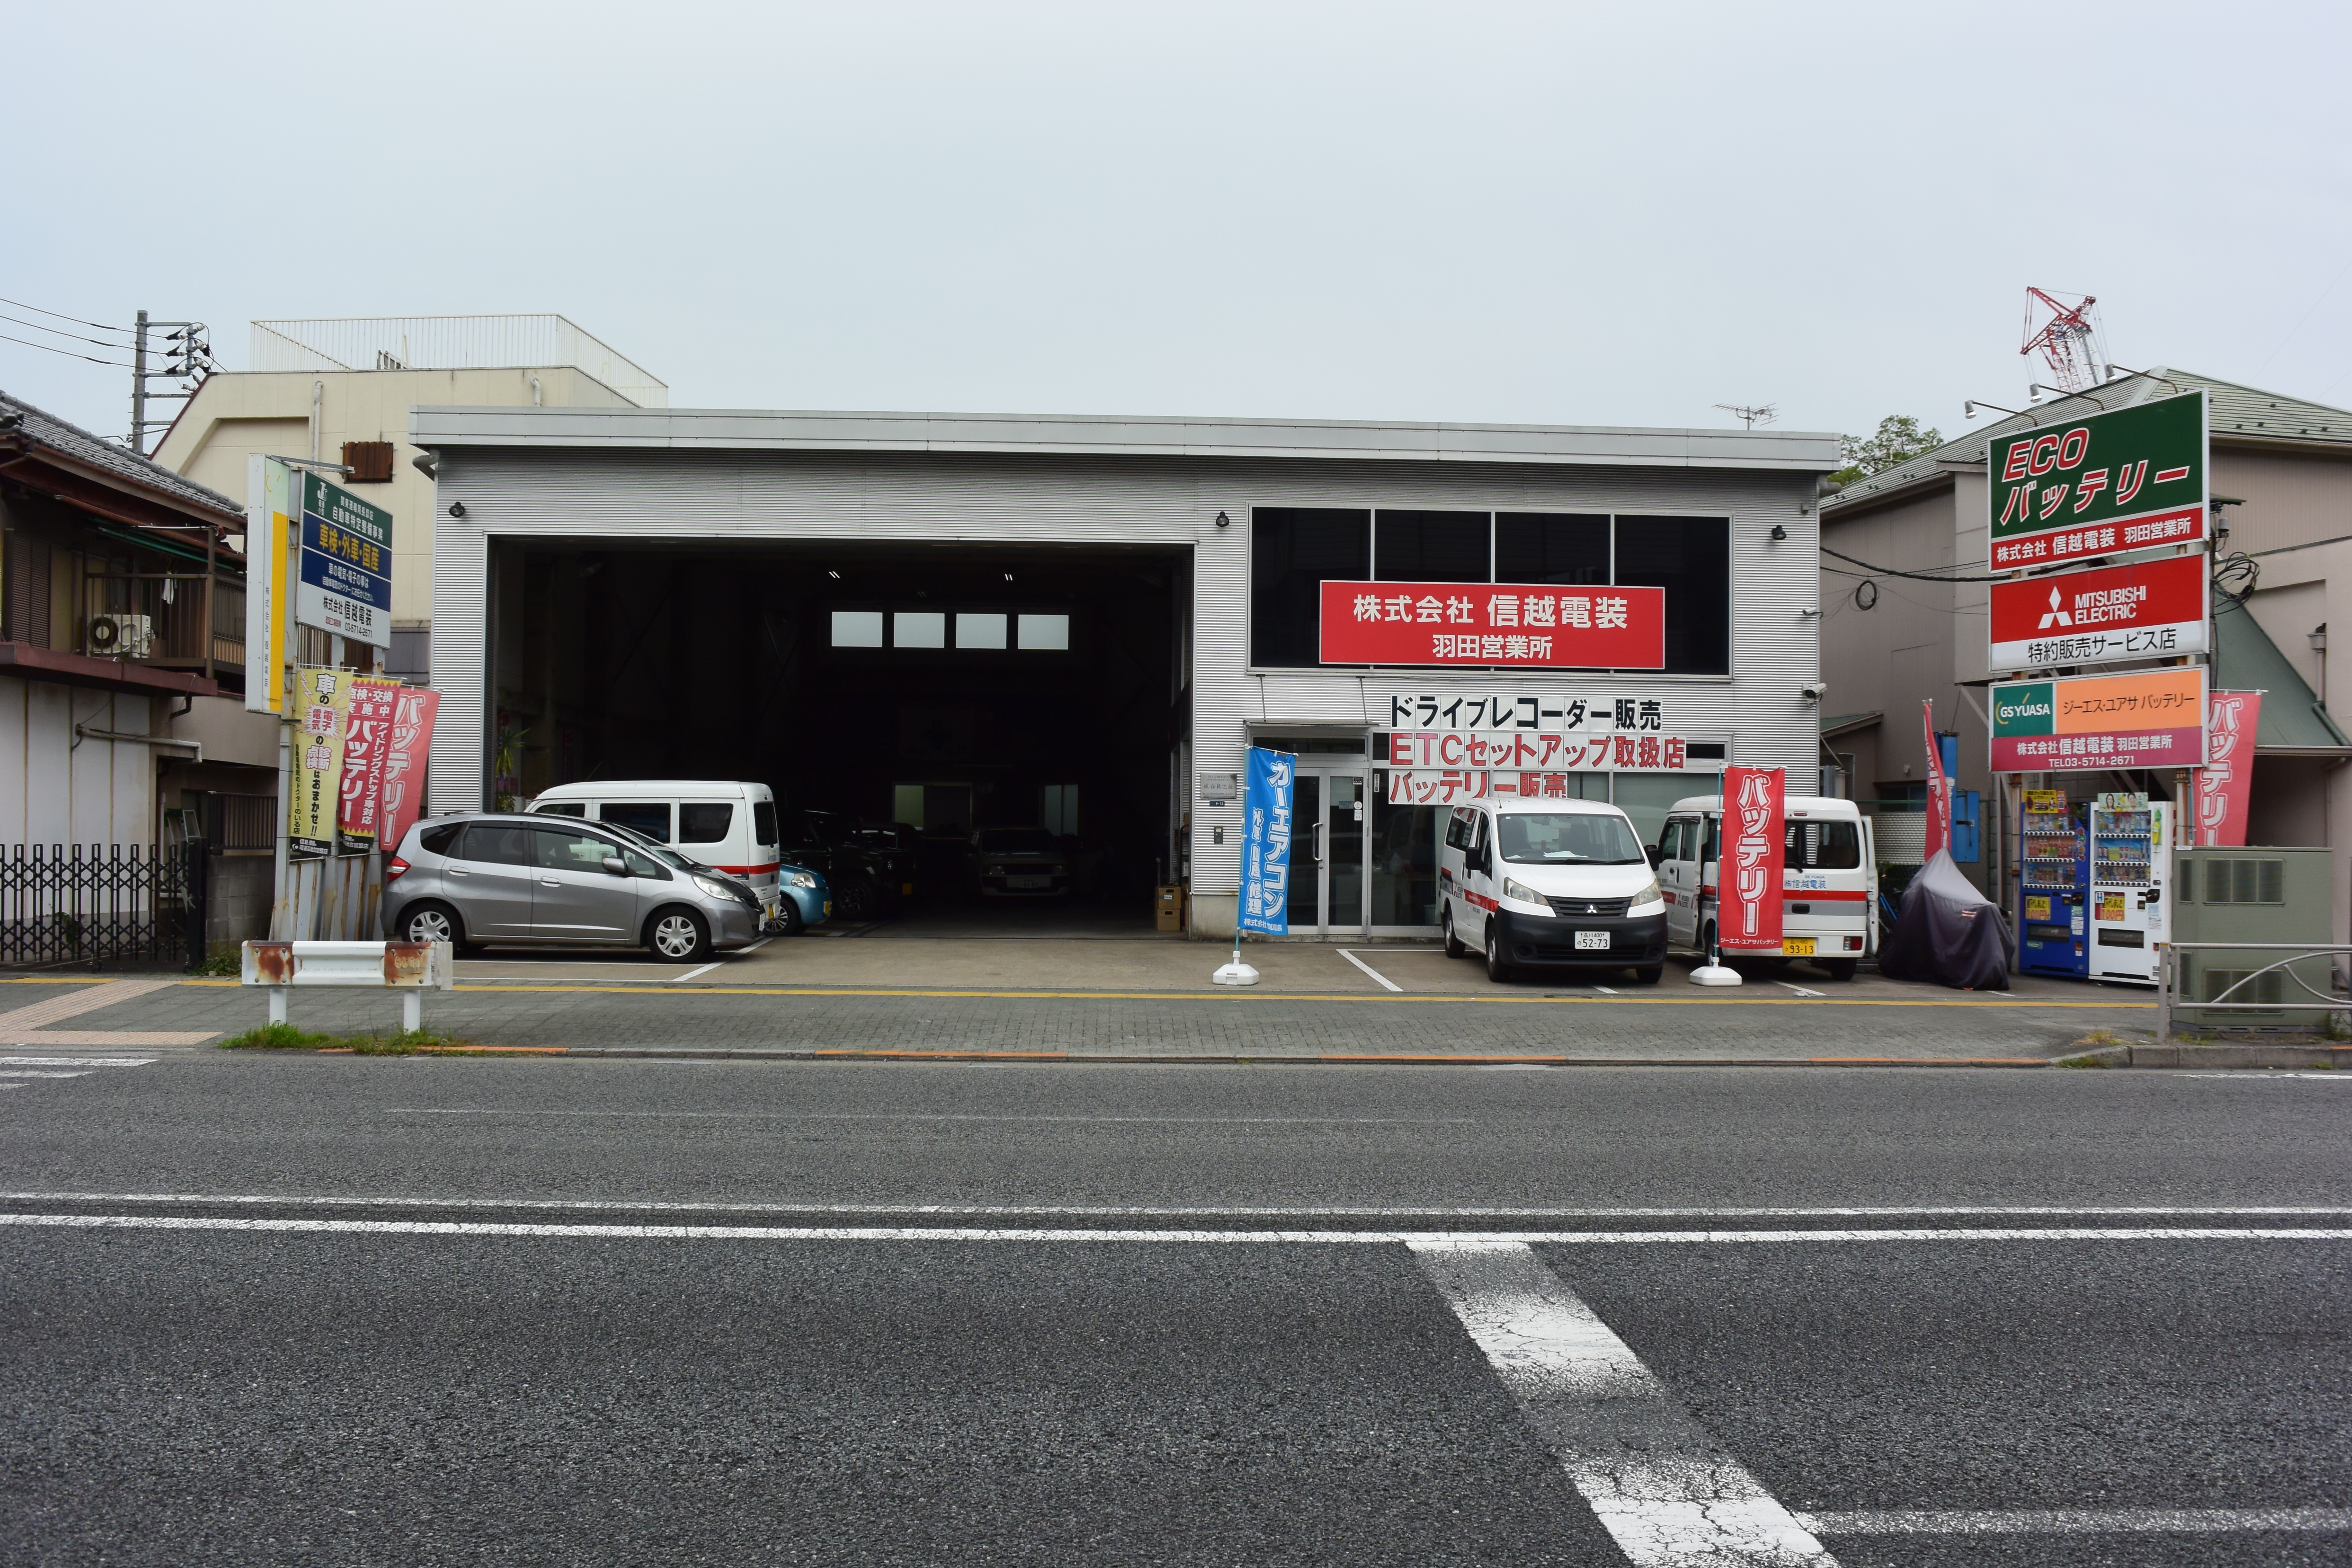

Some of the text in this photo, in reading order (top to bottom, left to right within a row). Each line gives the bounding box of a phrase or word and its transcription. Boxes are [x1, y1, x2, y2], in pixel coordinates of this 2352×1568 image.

[2002, 427, 2089, 482] ECO
[2000, 459, 2190, 526] バッテリー
[319, 524, 379, 571] 車検・外車・国産
[1997, 517, 2192, 563] 株式会社 信越電装 羽田営業所
[323, 595, 343, 615] 株式会社
[344, 600, 372, 627] 信越電装
[1354, 594, 1628, 629] 株式会社 信越電装
[2075, 585, 2146, 609] MITSUBISHI
[2075, 603, 2137, 624] ELECTRIC
[345, 622, 373, 638] 03-5714-2671
[2028, 628, 2177, 664] 特約販売サービス店
[1432, 634, 1553, 659] 羽田営業所
[351, 688, 393, 703] 点検・交換
[2000, 704, 2050, 718] GS YUASA
[2141, 693, 2195, 709] バッテリー
[1392, 696, 1661, 731] ドライブレコーダー販売
[1390, 733, 1684, 768] ETCセットアップ取扱店
[2017, 735, 2172, 756] 株式会社 信越電装 羽田営業所
[340, 720, 377, 822] バッテリー
[384, 695, 425, 846] バッテリー
[1390, 771, 1566, 803] バッテリー販売
[1263, 760, 1291, 919] カーエアコン
[1736, 774, 1771, 936] バッテリー
[1244, 918, 1267, 928] 株式会社
[1583, 939, 1608, 948] 52-73
[1790, 945, 1813, 954] 93-13
